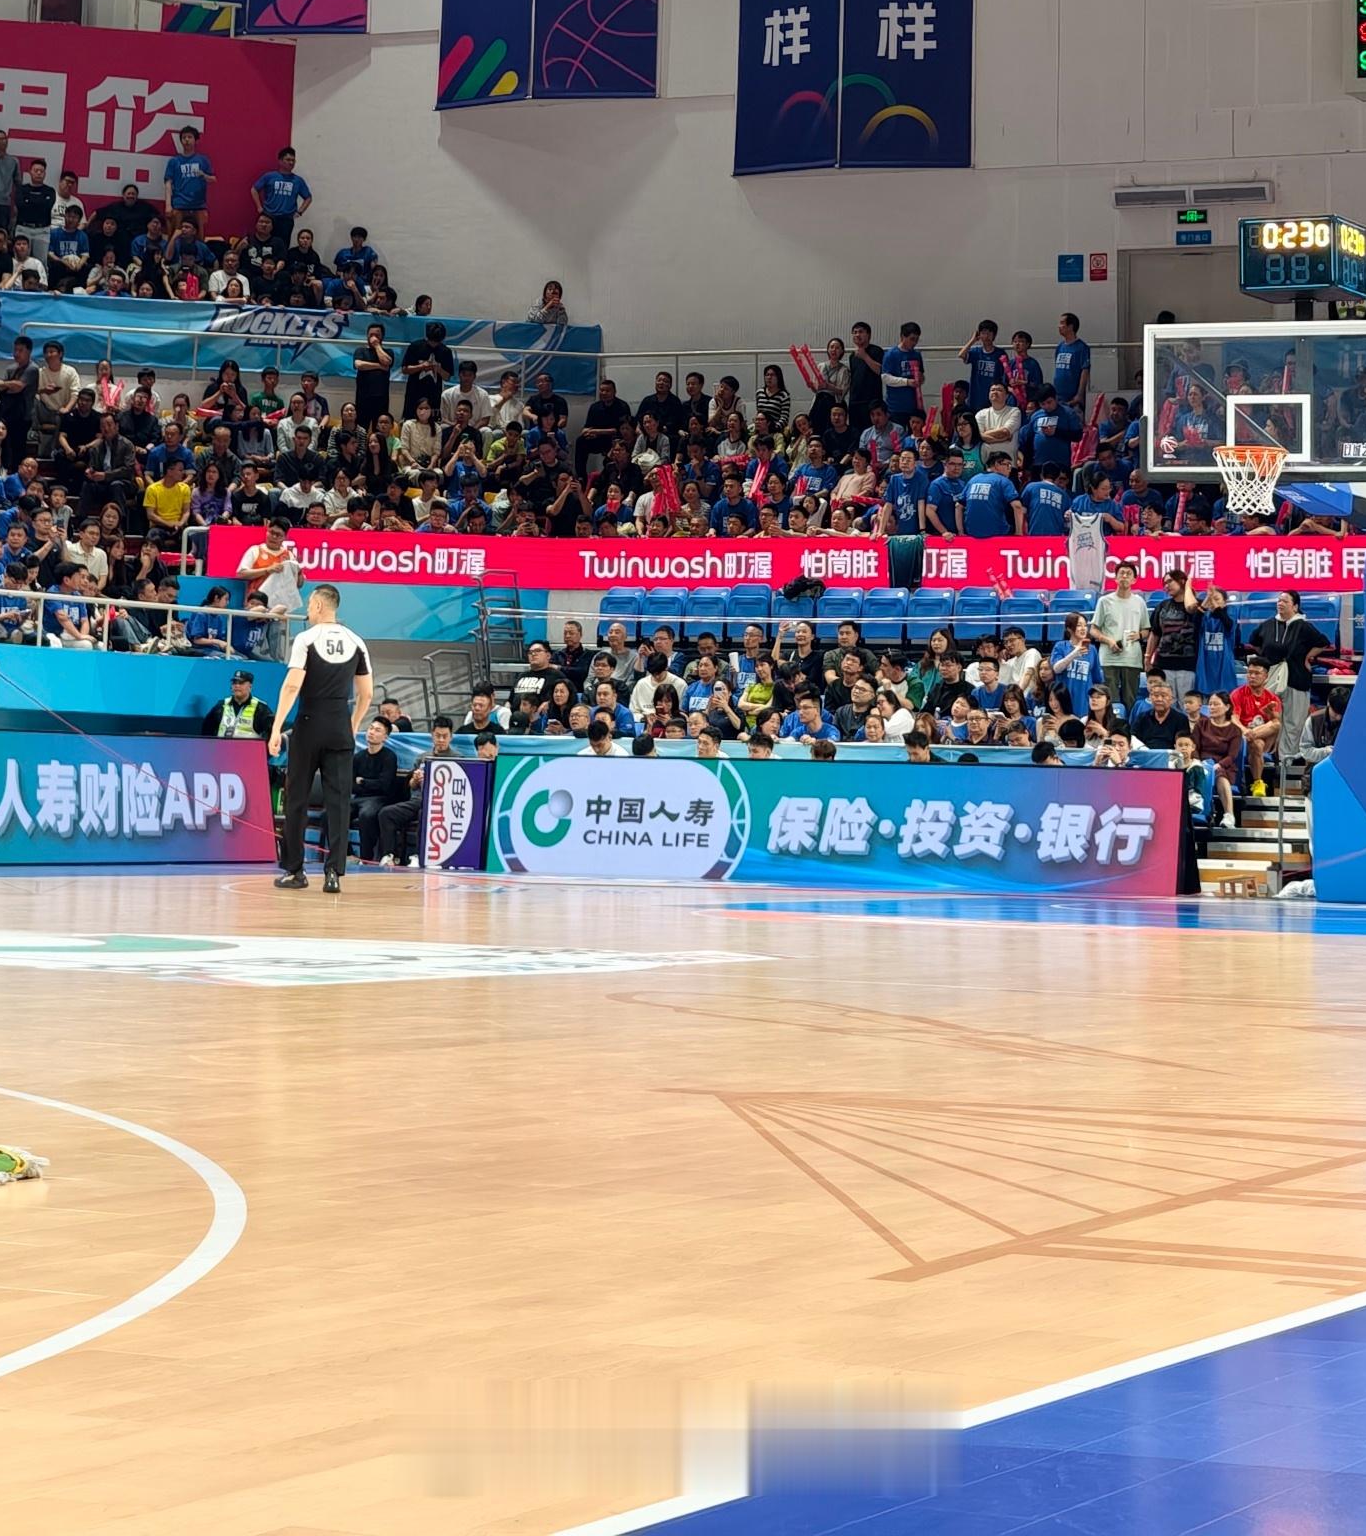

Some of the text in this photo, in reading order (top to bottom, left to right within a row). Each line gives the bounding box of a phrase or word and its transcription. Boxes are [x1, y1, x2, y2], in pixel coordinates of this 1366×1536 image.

[208, 302, 348, 342] ROCKETS
[579, 549, 773, 581] Twinwash町渥
[800, 547, 879, 579] 怕筒脏
[1246, 547, 1333, 579] 怕筒脏
[326, 639, 344, 656] 54
[449, 777, 467, 842] 百岁山
[586, 794, 715, 827] 中国人寿
[583, 829, 710, 849] CHINA LIFE
[766, 795, 1154, 866] 保险·投资·银行
